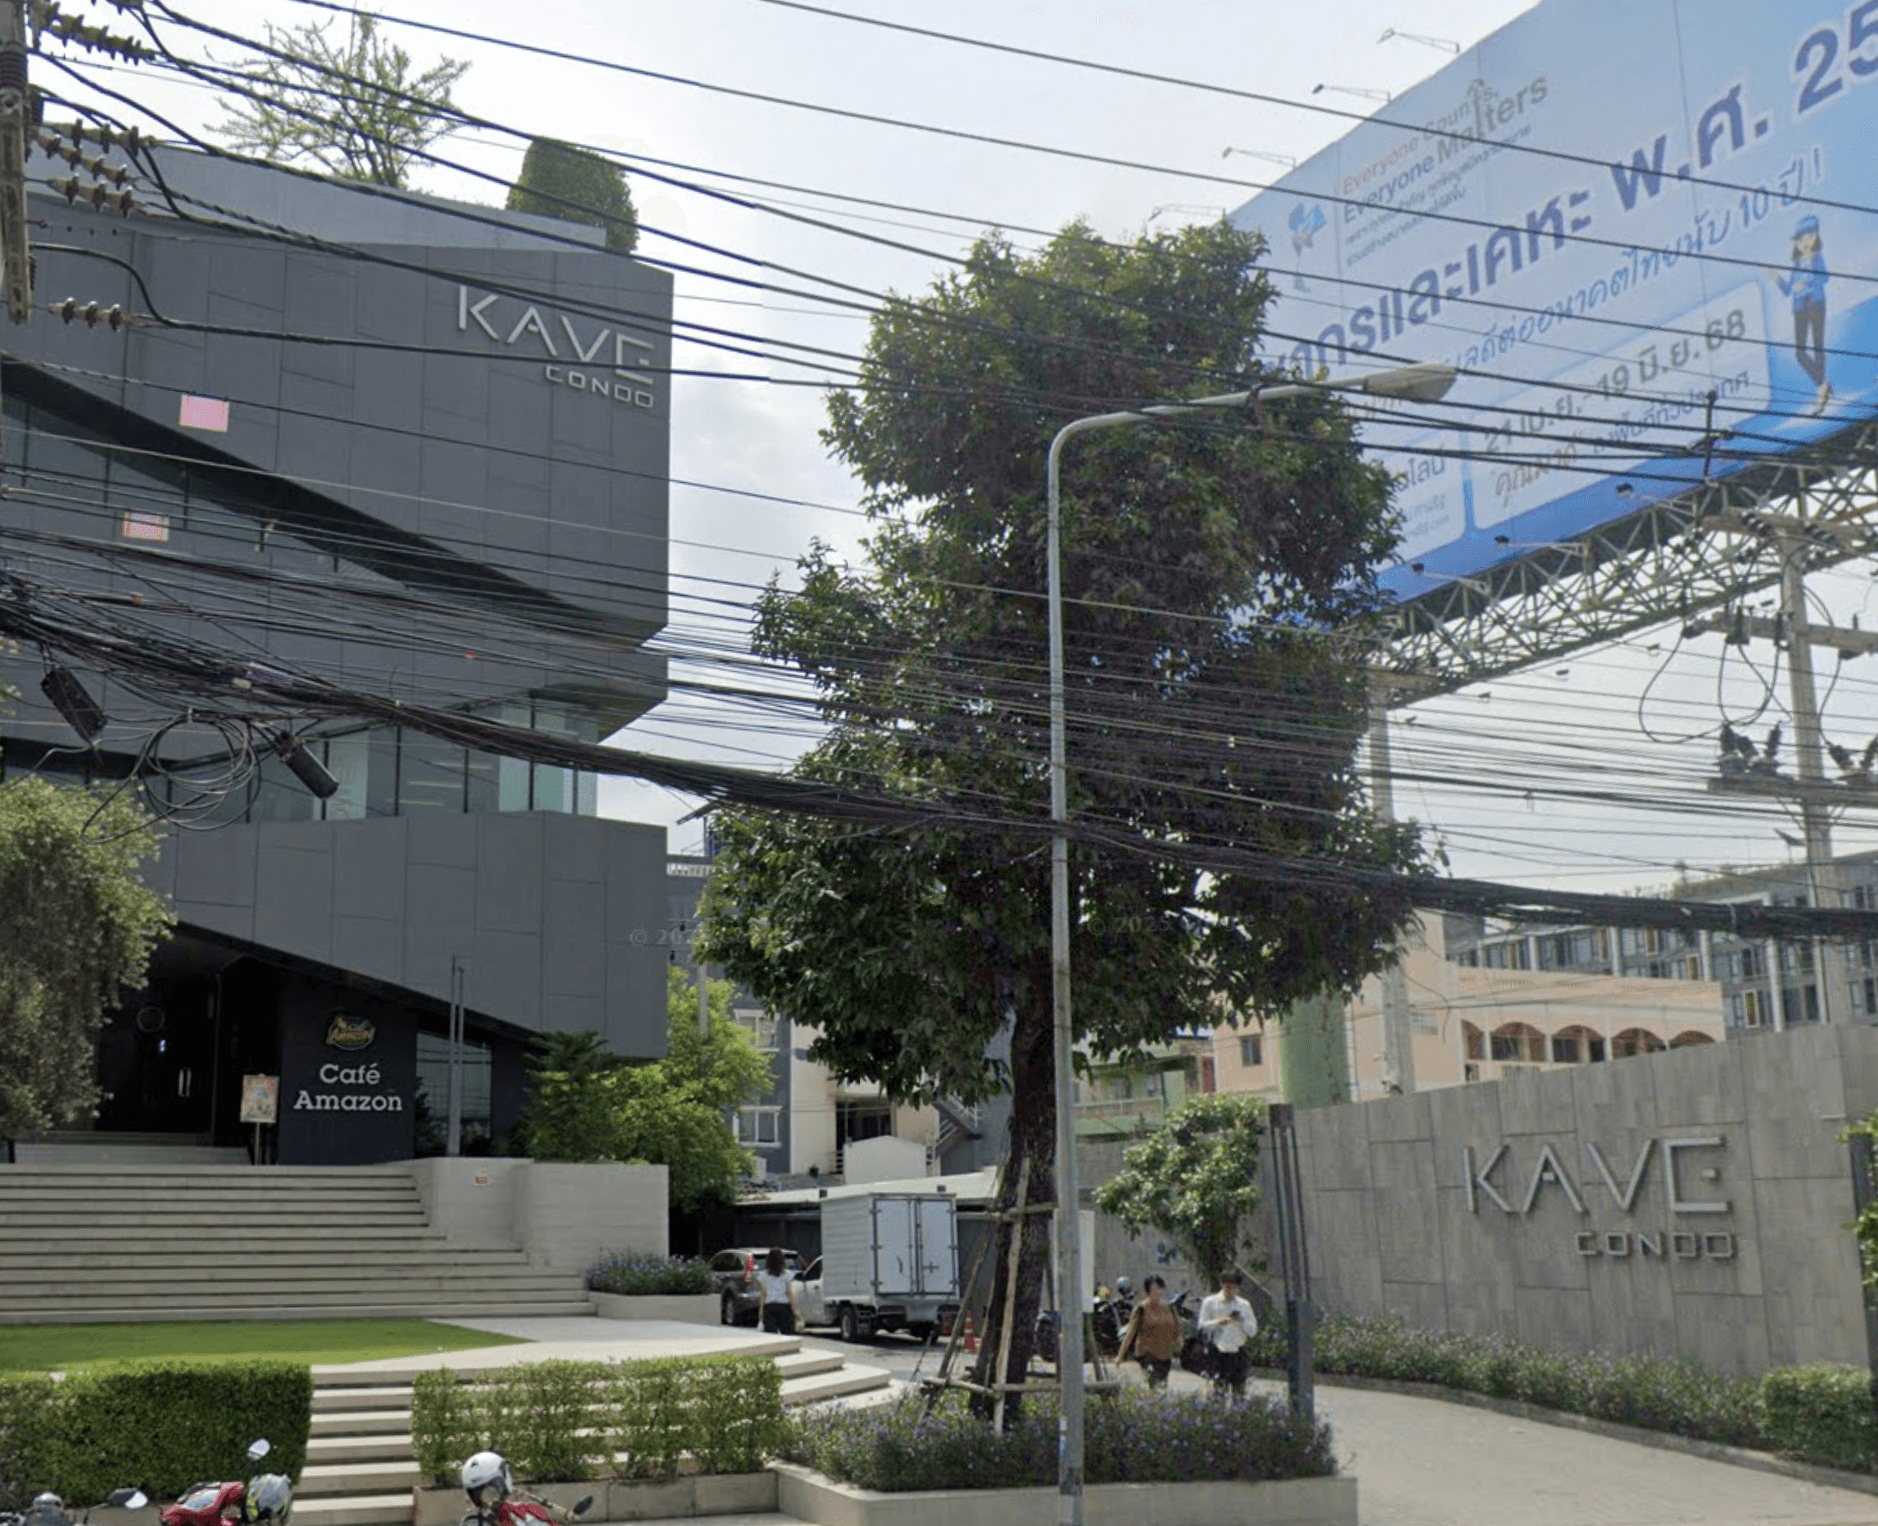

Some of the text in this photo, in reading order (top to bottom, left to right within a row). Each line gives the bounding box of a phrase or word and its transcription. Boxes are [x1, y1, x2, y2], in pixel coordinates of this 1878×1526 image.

[1343, 137, 1419, 195] Everyone
[1610, 83, 1769, 212] พ.ศ.
[1343, 154, 1435, 224] Everyone
[1738, 183, 1770, 229] 10
[458, 285, 655, 385] KAVE
[1704, 308, 1746, 350] 68
[545, 364, 654, 408] CONDO
[318, 1062, 382, 1085] Café
[293, 1089, 403, 1112] Amazon
[1463, 1136, 1731, 1214] KAVE
[1576, 1231, 1733, 1258] CONDO
